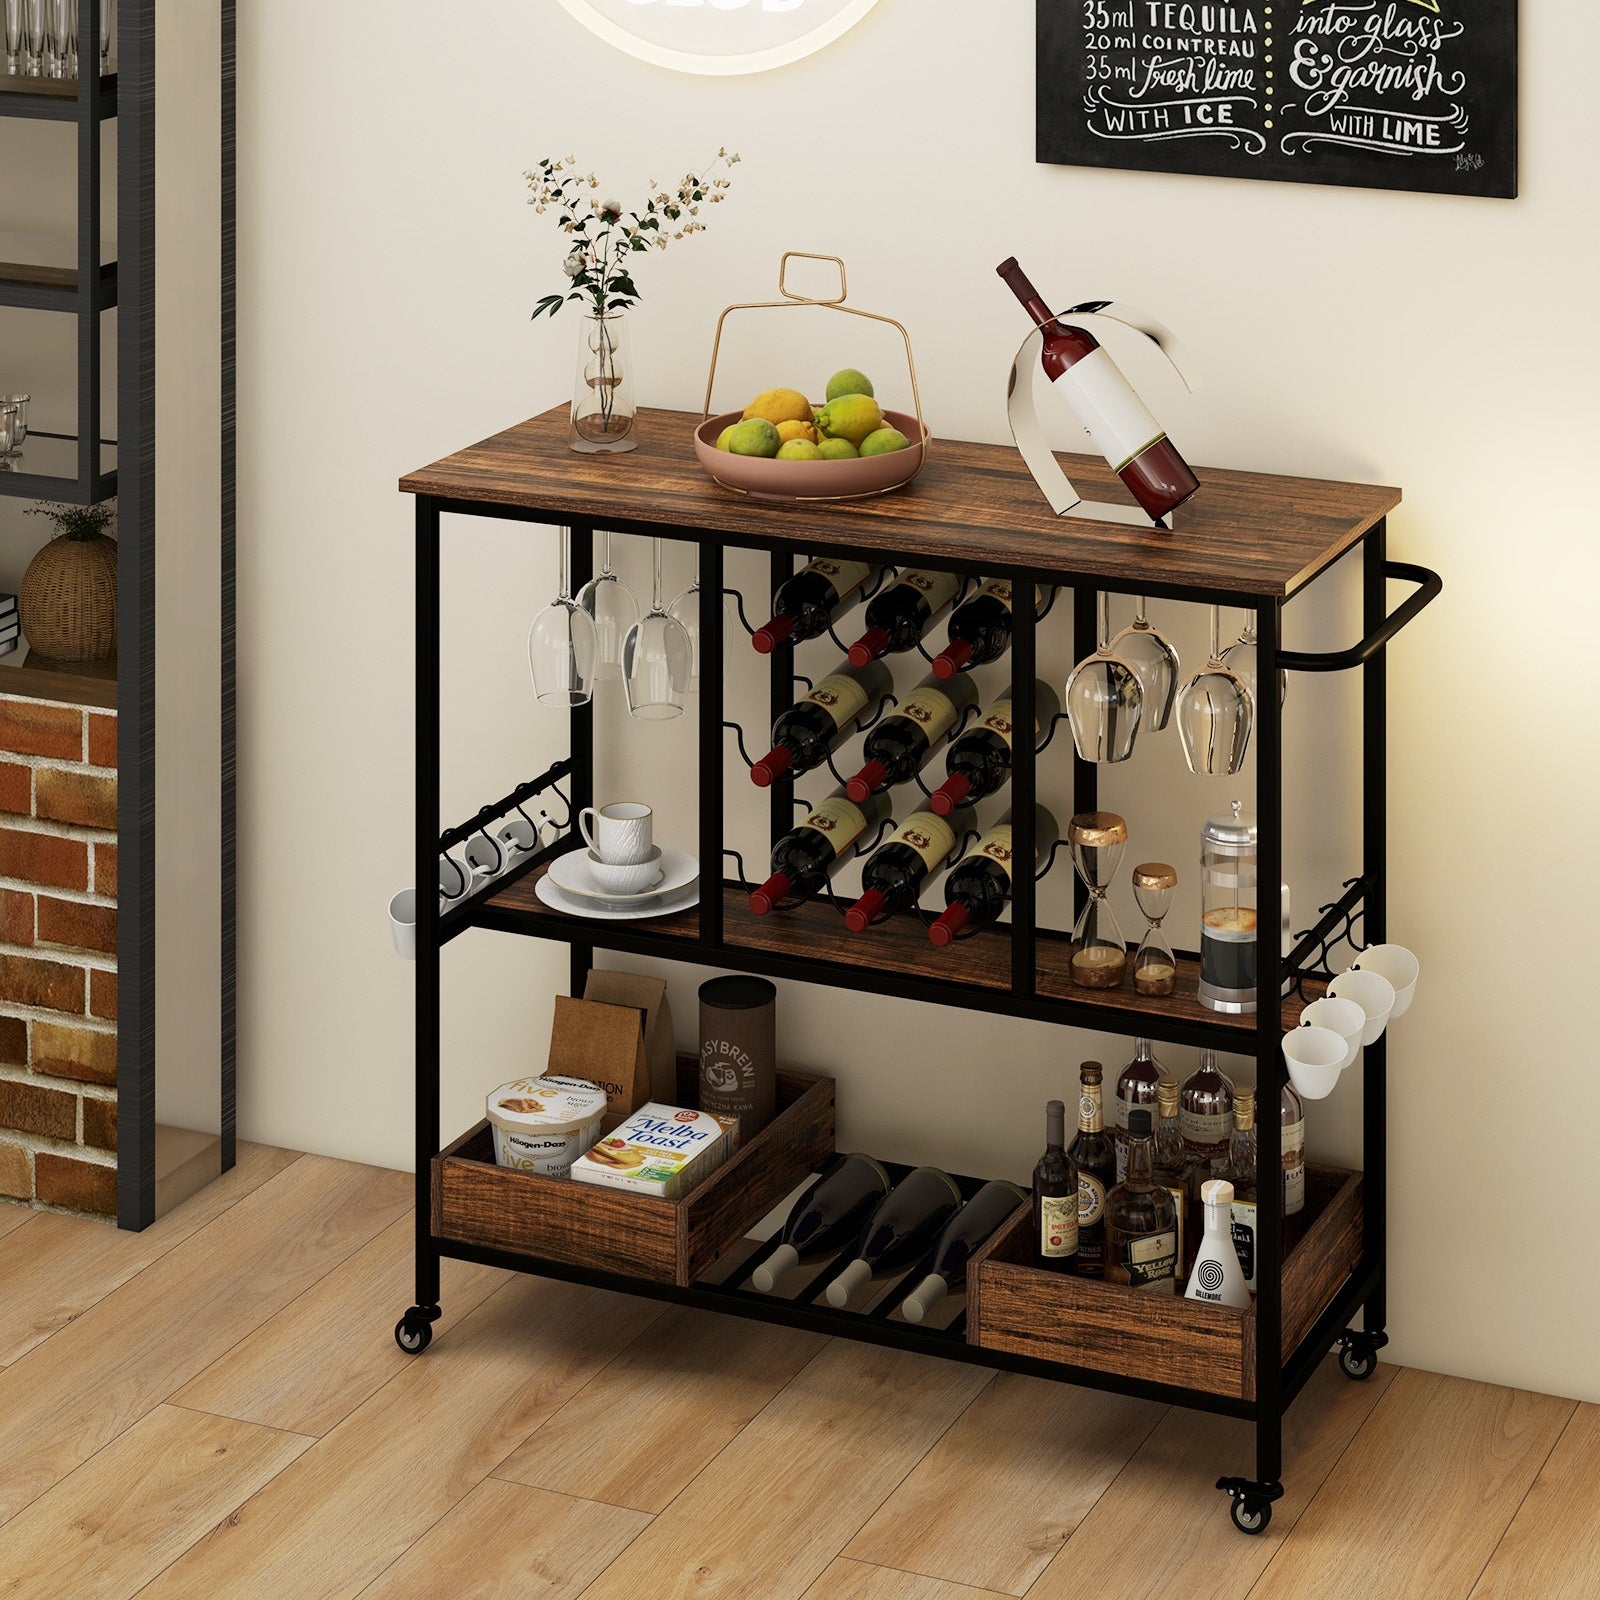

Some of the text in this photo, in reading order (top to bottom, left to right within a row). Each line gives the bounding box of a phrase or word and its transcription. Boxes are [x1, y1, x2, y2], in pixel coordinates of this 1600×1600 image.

[1083, 0, 1258, 35] 35ml TEQUILA
[1289, 2, 1464, 63] into glass
[1142, 34, 1255, 58] COINTREAU
[1086, 54, 1256, 98] 35ml fresh lime
[1305, 54, 1466, 116] garnish
[1104, 104, 1234, 131] WITH ICE
[1330, 113, 1441, 146] WITH LIME
[626, 1118, 709, 1141] Melba
[628, 1129, 693, 1149] Toast
